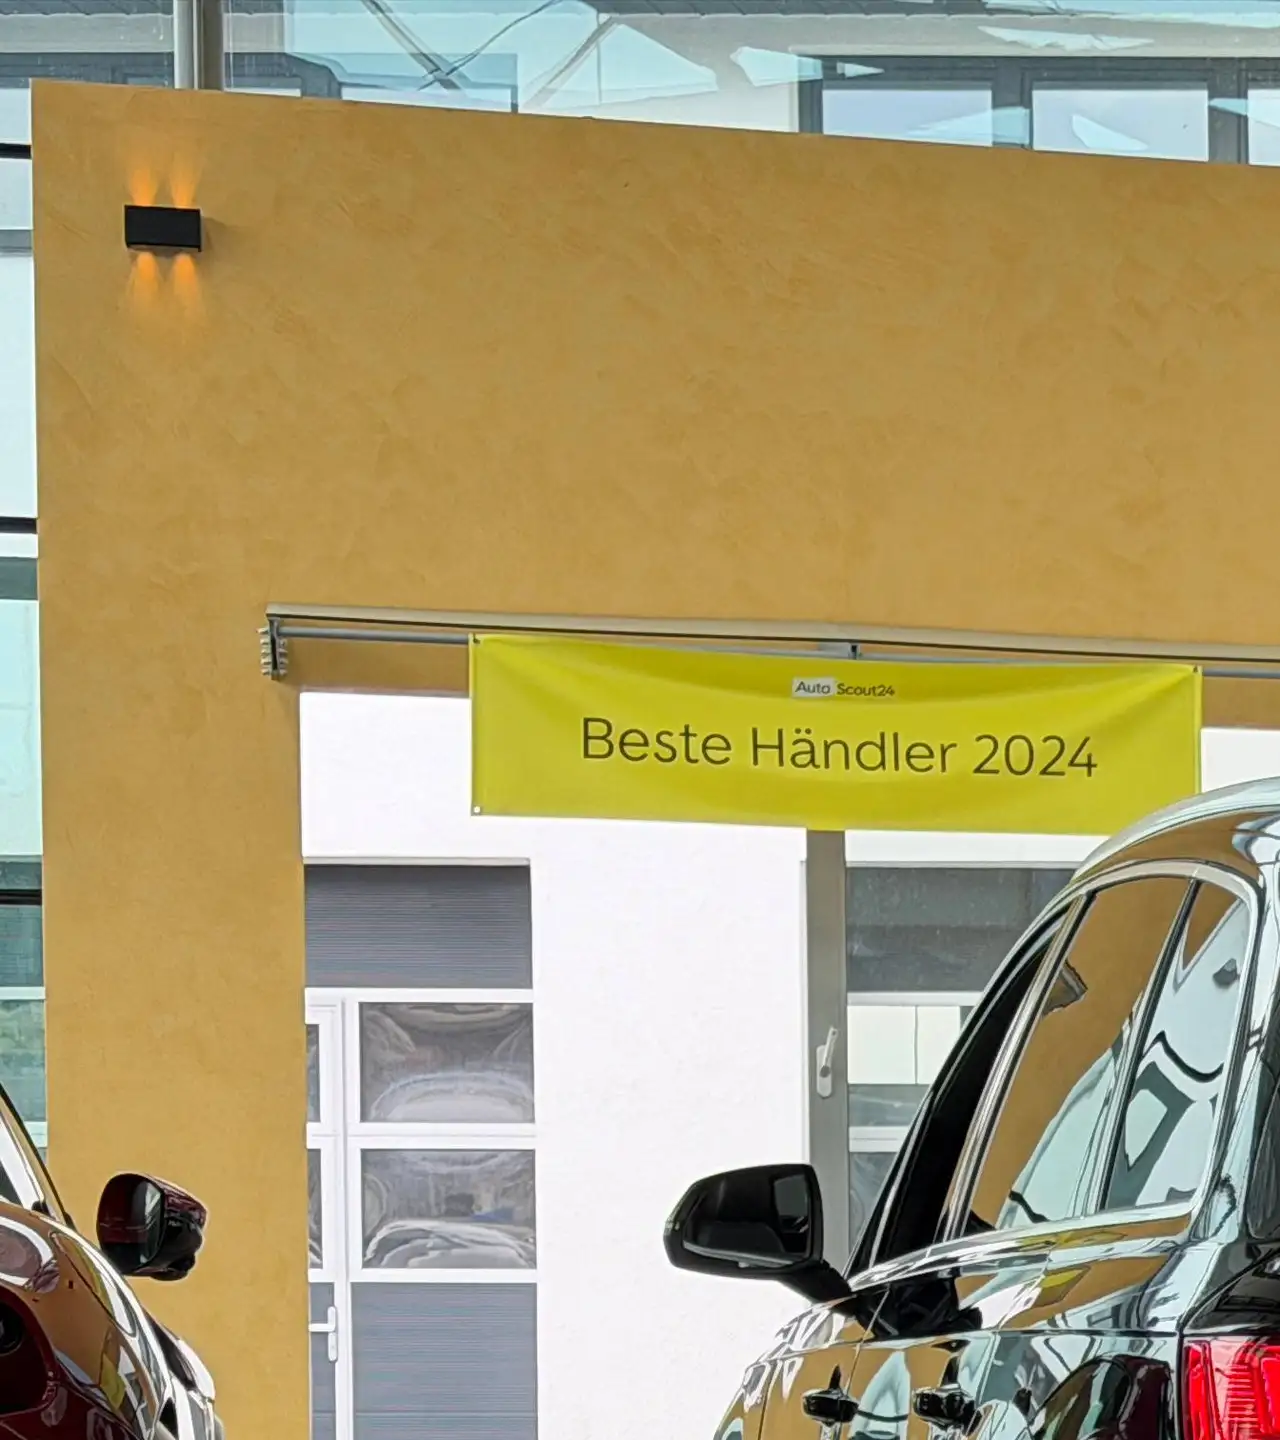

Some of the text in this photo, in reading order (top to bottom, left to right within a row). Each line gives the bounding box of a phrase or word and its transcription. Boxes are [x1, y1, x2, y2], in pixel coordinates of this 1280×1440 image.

[581, 716, 1098, 778] Beste Händler 2024
